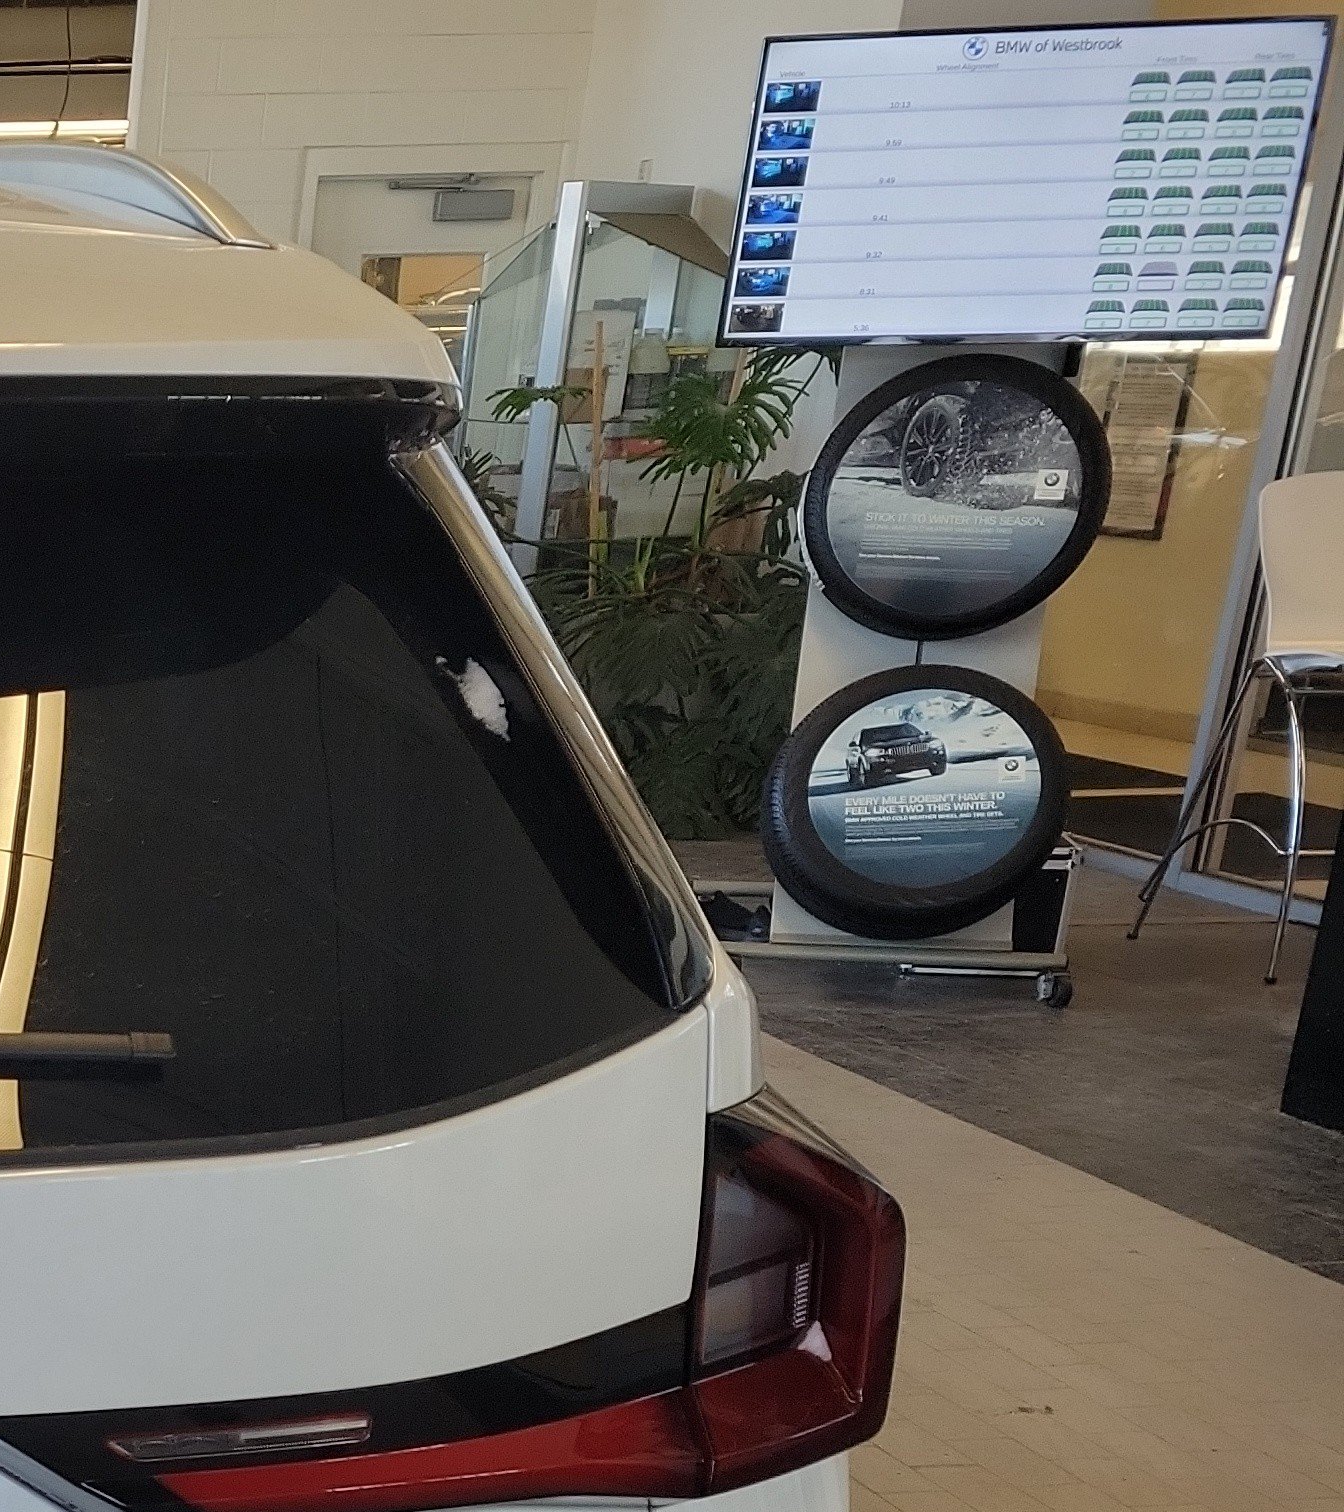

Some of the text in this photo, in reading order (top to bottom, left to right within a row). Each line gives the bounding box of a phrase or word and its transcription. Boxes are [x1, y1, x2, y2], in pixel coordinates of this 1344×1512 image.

[995, 37, 1124, 54] BMW of Westbrook
[928, 514, 970, 525] WINTER
[973, 515, 997, 526] THIS
[845, 790, 1006, 807] EVERY MILE DOESN'T HAVE TO
[844, 805, 871, 816] FEEL
[873, 804, 898, 815] LIKE
[898, 803, 925, 814] TWO
[926, 802, 952, 812] THIS
